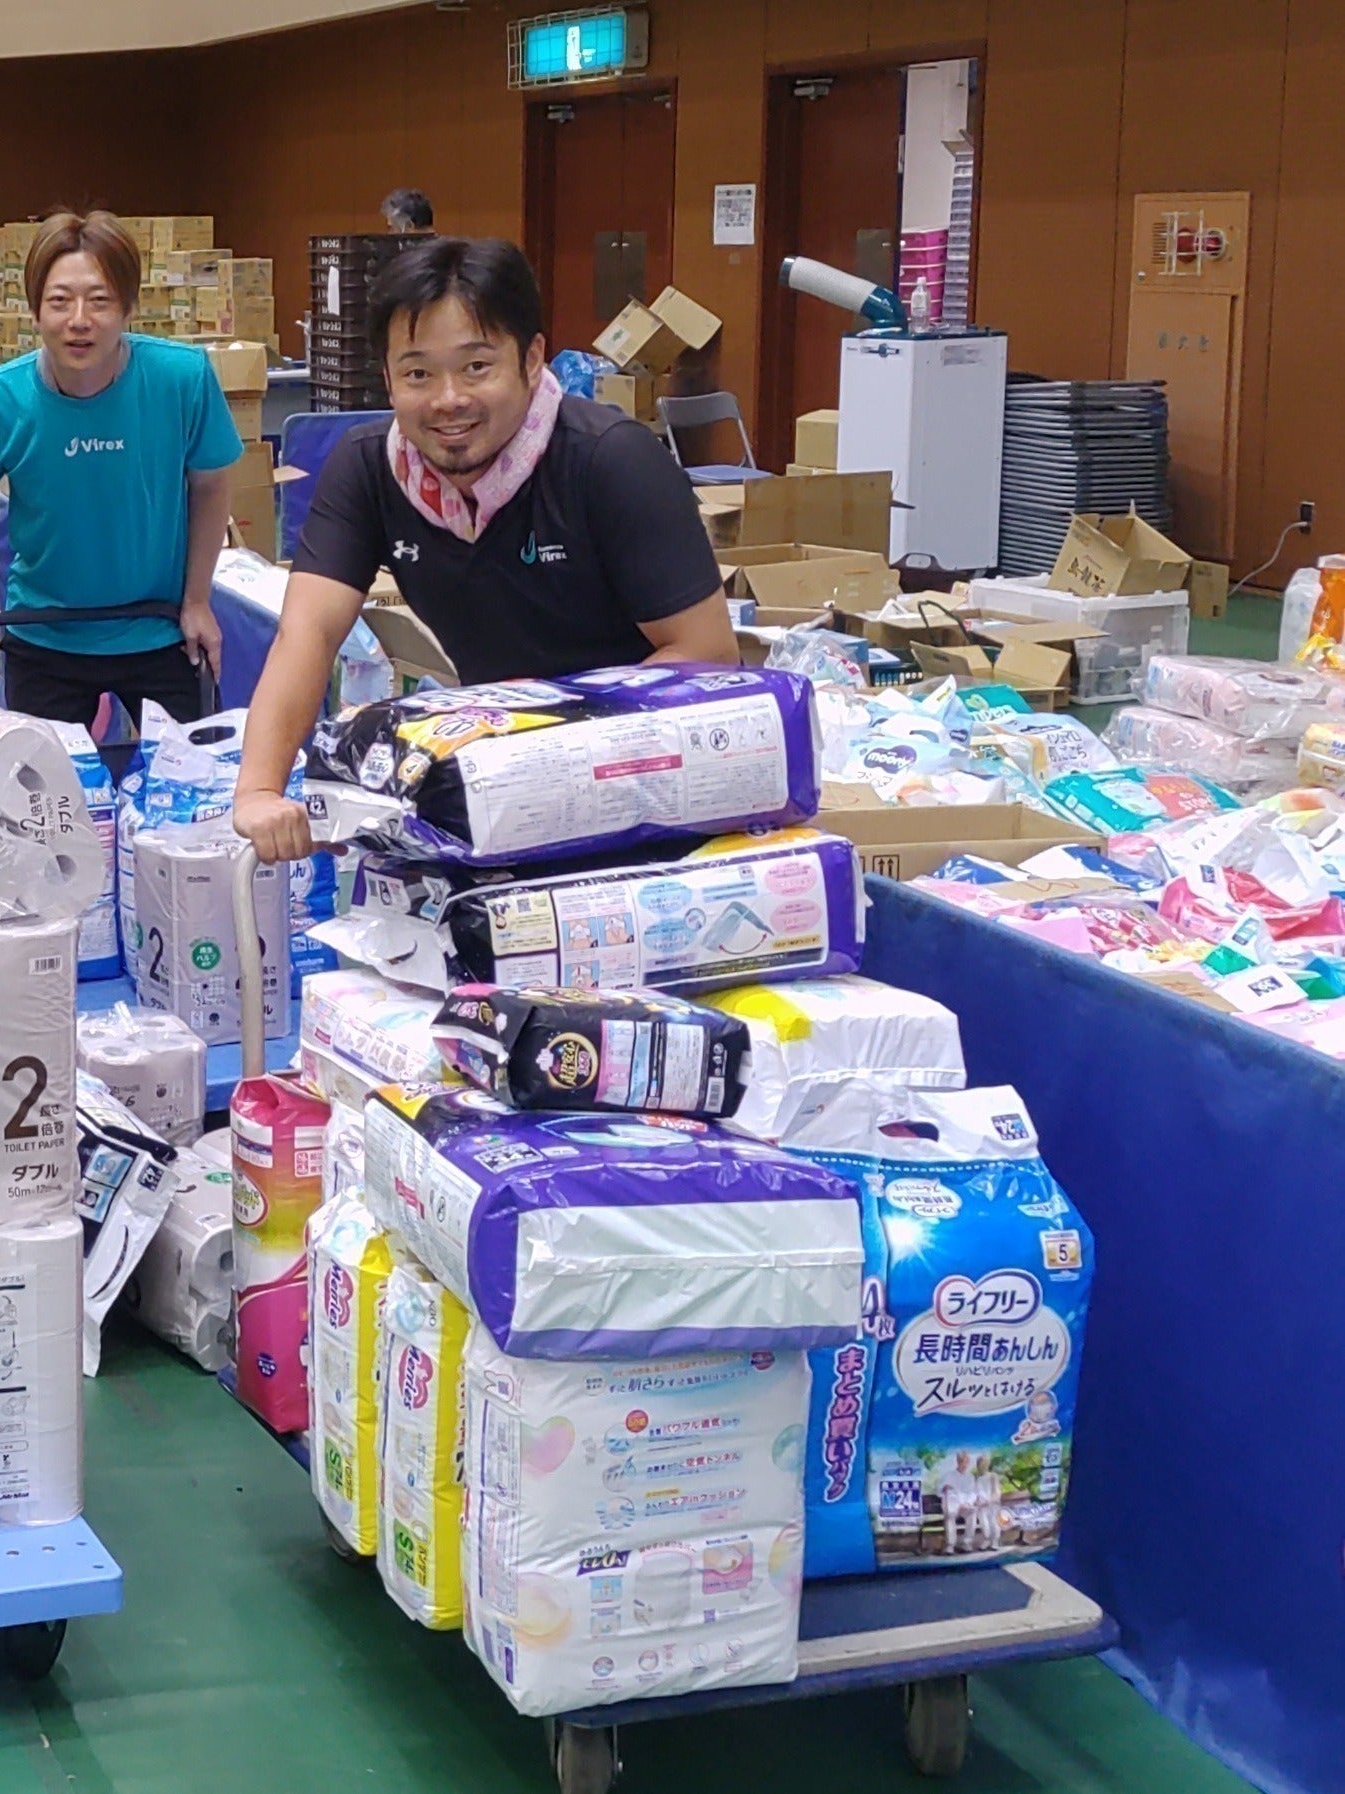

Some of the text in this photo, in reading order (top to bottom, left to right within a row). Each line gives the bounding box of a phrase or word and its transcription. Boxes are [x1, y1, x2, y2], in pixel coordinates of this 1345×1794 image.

[80, 438, 124, 453] Virex
[2, 1056, 48, 1140] 2
[4, 1138, 65, 1153] TOILET PAPER
[12, 1164, 59, 1182] ダブル
[327, 1258, 344, 1330] Merries
[948, 1290, 1029, 1315] ライフリー
[913, 1332, 1059, 1363] 長時間あんしん
[403, 1346, 421, 1411] Merries
[917, 1377, 1036, 1408] スルッとはける
